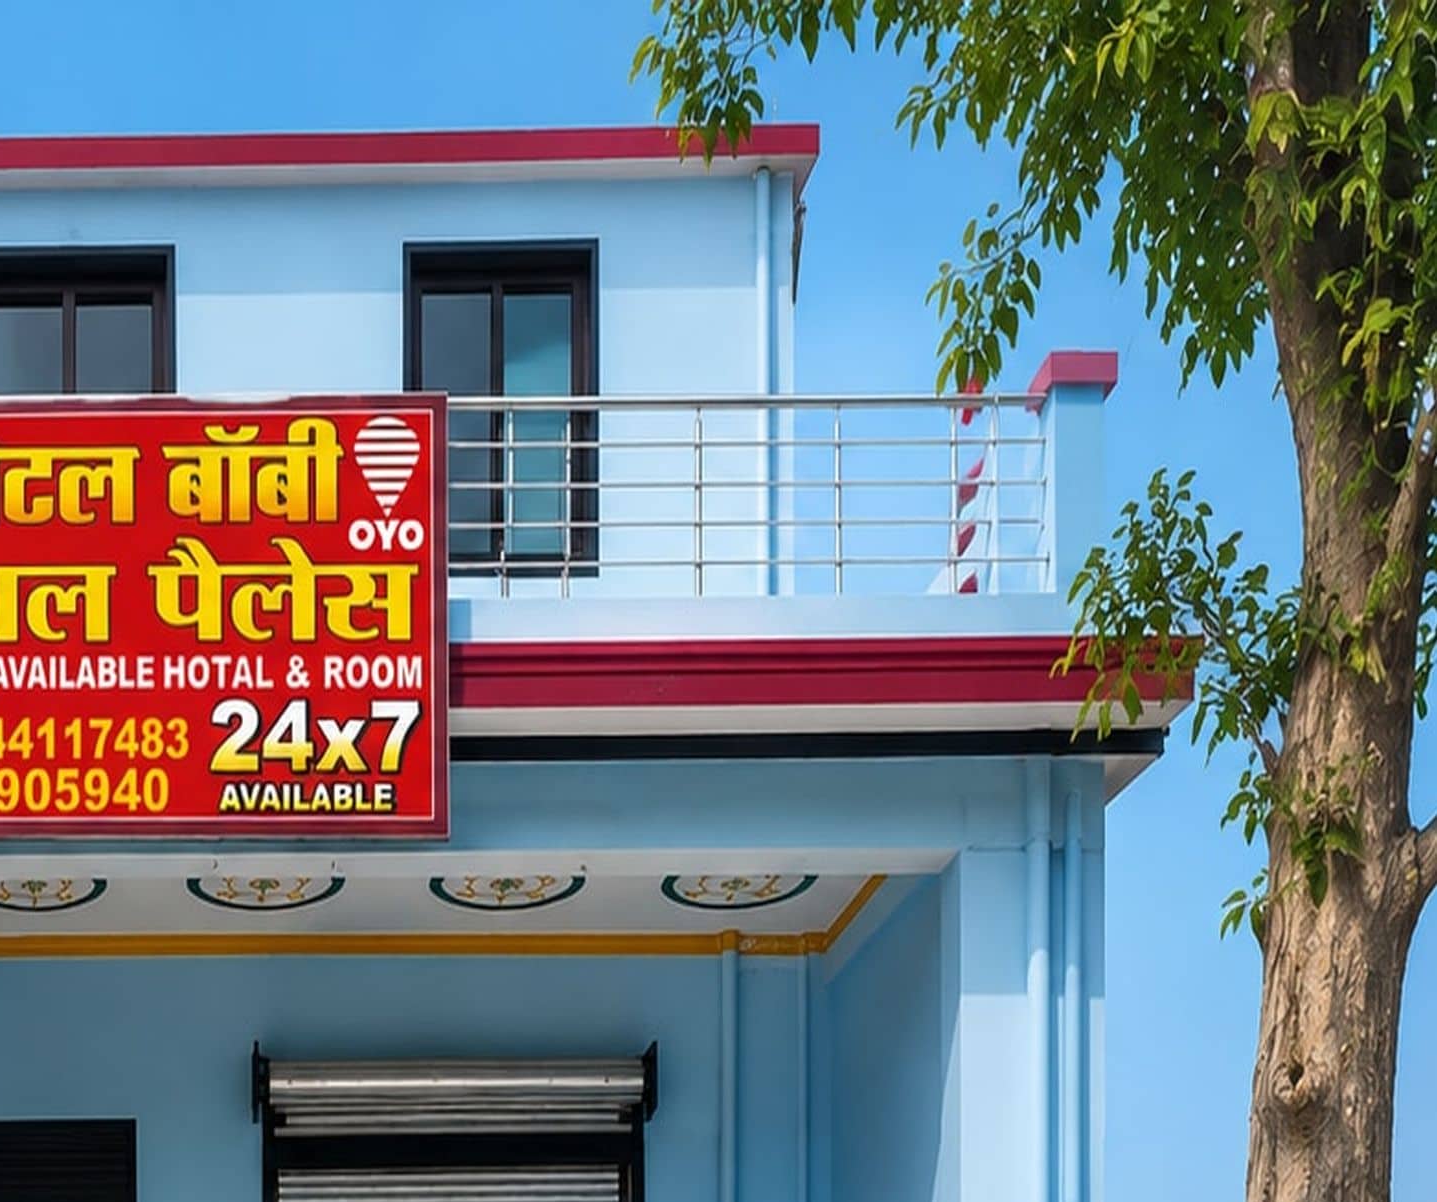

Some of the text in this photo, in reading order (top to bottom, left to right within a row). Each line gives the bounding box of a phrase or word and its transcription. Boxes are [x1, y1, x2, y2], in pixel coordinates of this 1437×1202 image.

[162, 416, 343, 524] बॉबी
[348, 519, 424, 551] OYO
[148, 537, 420, 643] पैलेस
[163, 655, 273, 690] HOTAL
[286, 656, 310, 690] &
[324, 654, 422, 690] ROOM
[209, 698, 422, 775] 24x7
[219, 783, 394, 813] AVAILABLE
